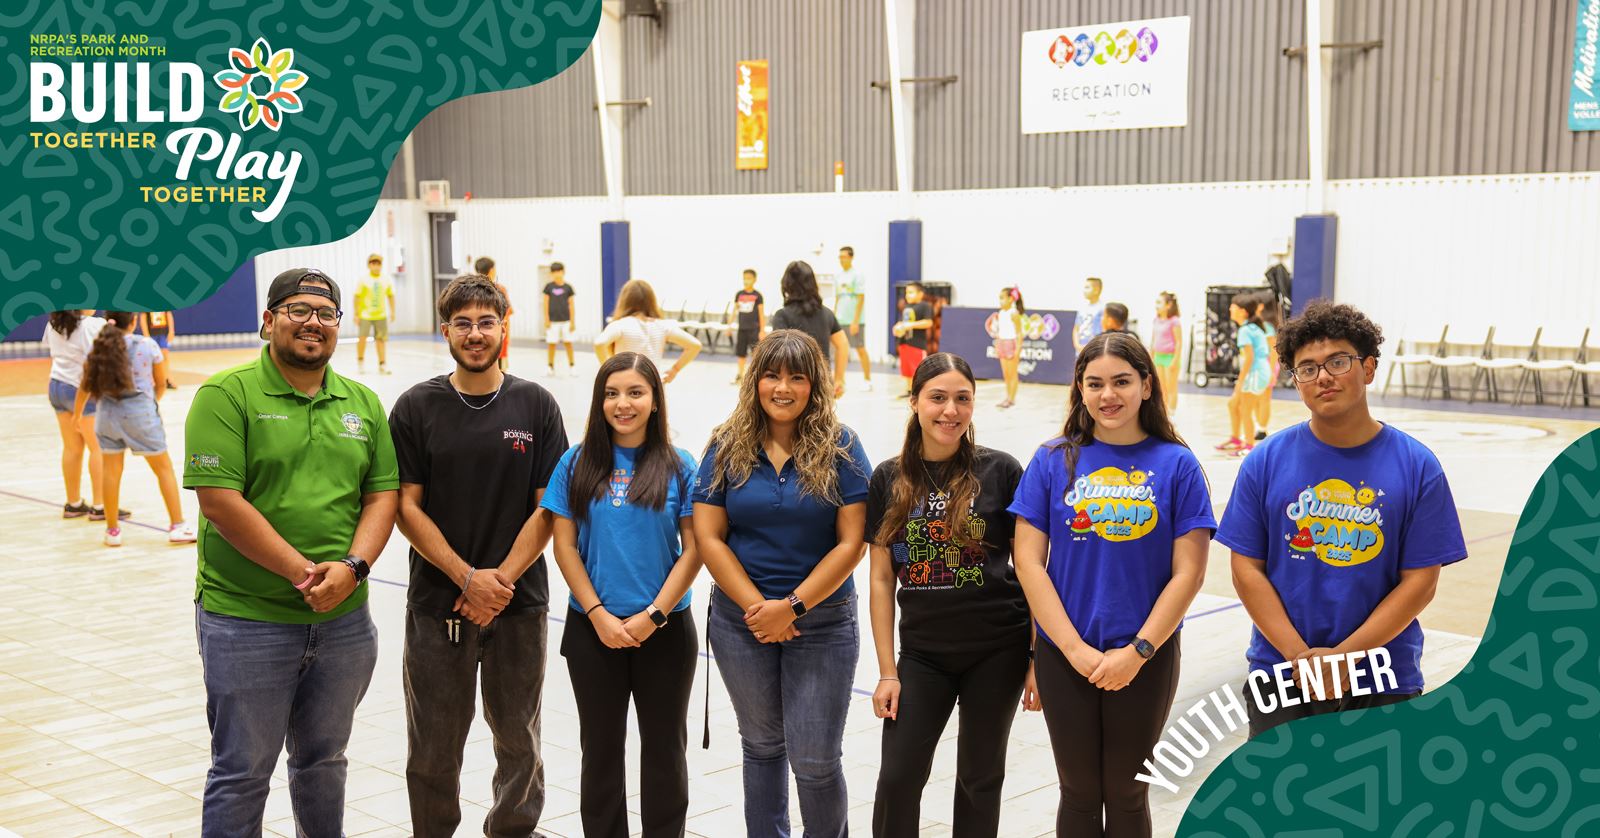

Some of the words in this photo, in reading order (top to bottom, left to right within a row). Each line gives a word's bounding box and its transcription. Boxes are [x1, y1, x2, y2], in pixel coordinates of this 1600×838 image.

[1574, 0, 1600, 97] Motivatio
[1052, 82, 1151, 101] RECREATION
[503, 430, 533, 442] BOXING
[1064, 475, 1156, 506] Summer
[1086, 503, 1153, 526] CAMP
[1286, 488, 1384, 526] Summer
[1106, 525, 1131, 536] 2025
[1309, 522, 1378, 551] CAMP
[1326, 549, 1352, 561] 2025
